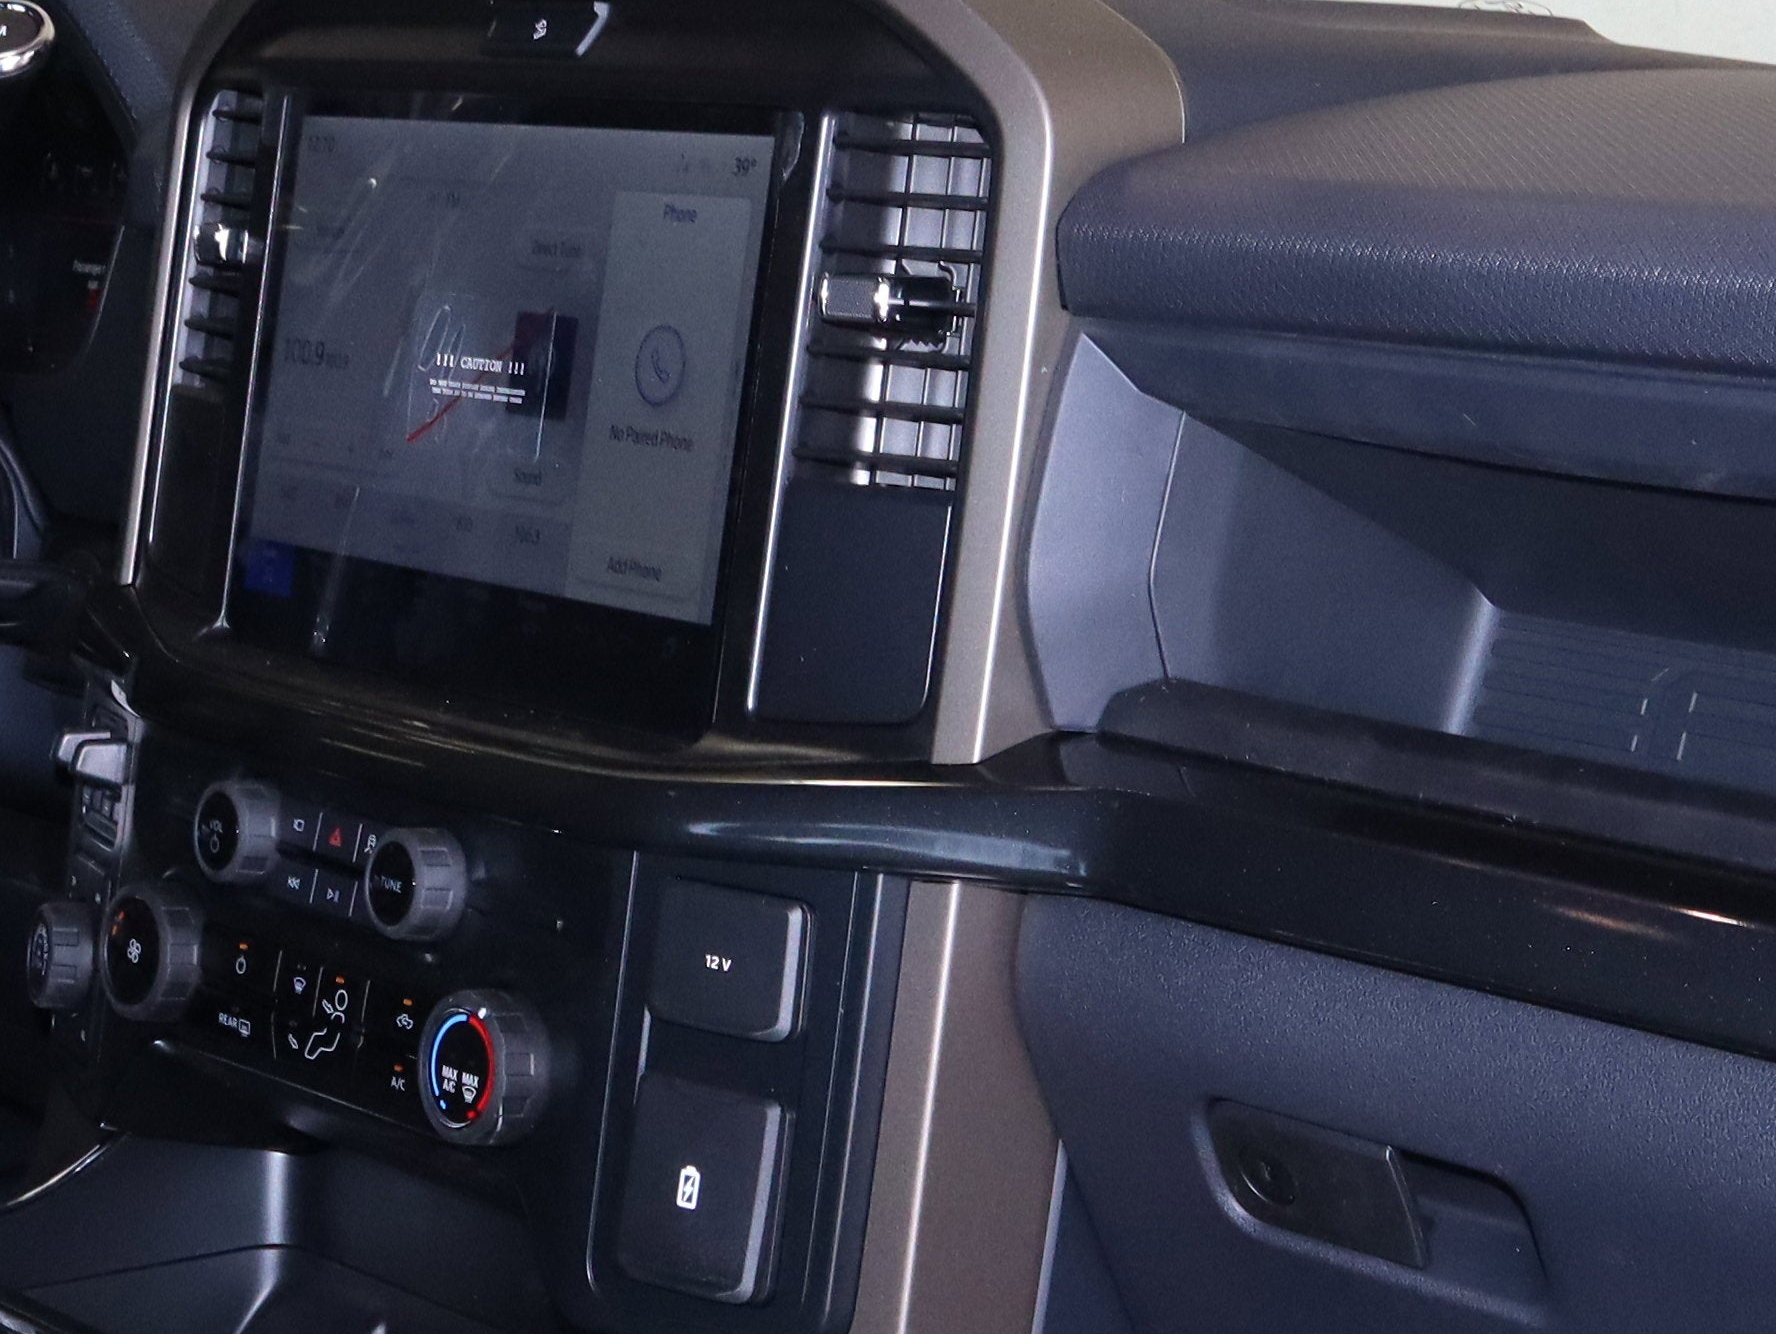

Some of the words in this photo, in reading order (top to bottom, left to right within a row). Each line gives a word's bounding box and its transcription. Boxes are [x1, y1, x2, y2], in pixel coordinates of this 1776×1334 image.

[460, 356, 503, 373] CAUTION
[379, 876, 404, 893] TUNE
[705, 954, 720, 970] 12
[722, 957, 732, 972] V
[218, 1013, 238, 1029] REAR
[441, 1065, 458, 1082] MAX
[461, 1072, 480, 1089] MAX
[390, 1075, 406, 1092] A/C
